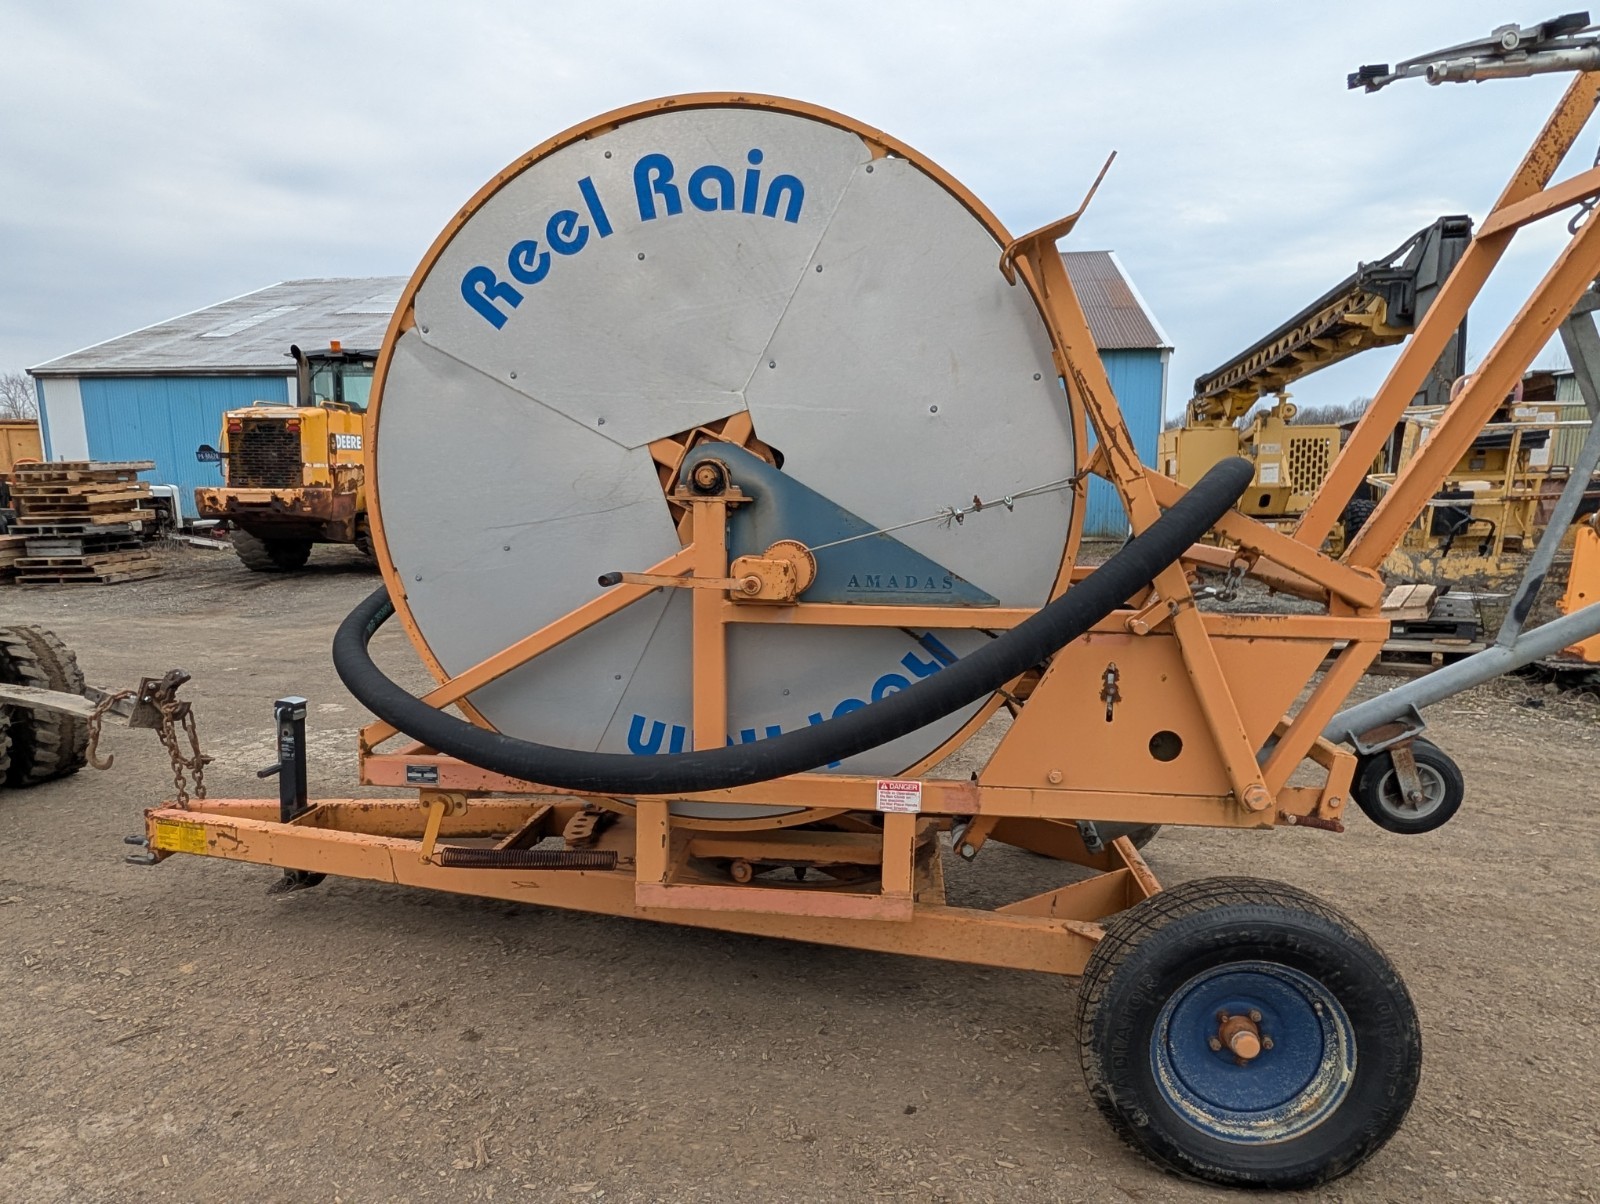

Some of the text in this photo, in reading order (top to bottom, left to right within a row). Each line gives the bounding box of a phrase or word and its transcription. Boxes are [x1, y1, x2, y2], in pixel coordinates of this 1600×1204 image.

[460, 148, 806, 331] Reel Rain
[336, 434, 362, 449] DEERE
[847, 574, 953, 589] AMADAS
